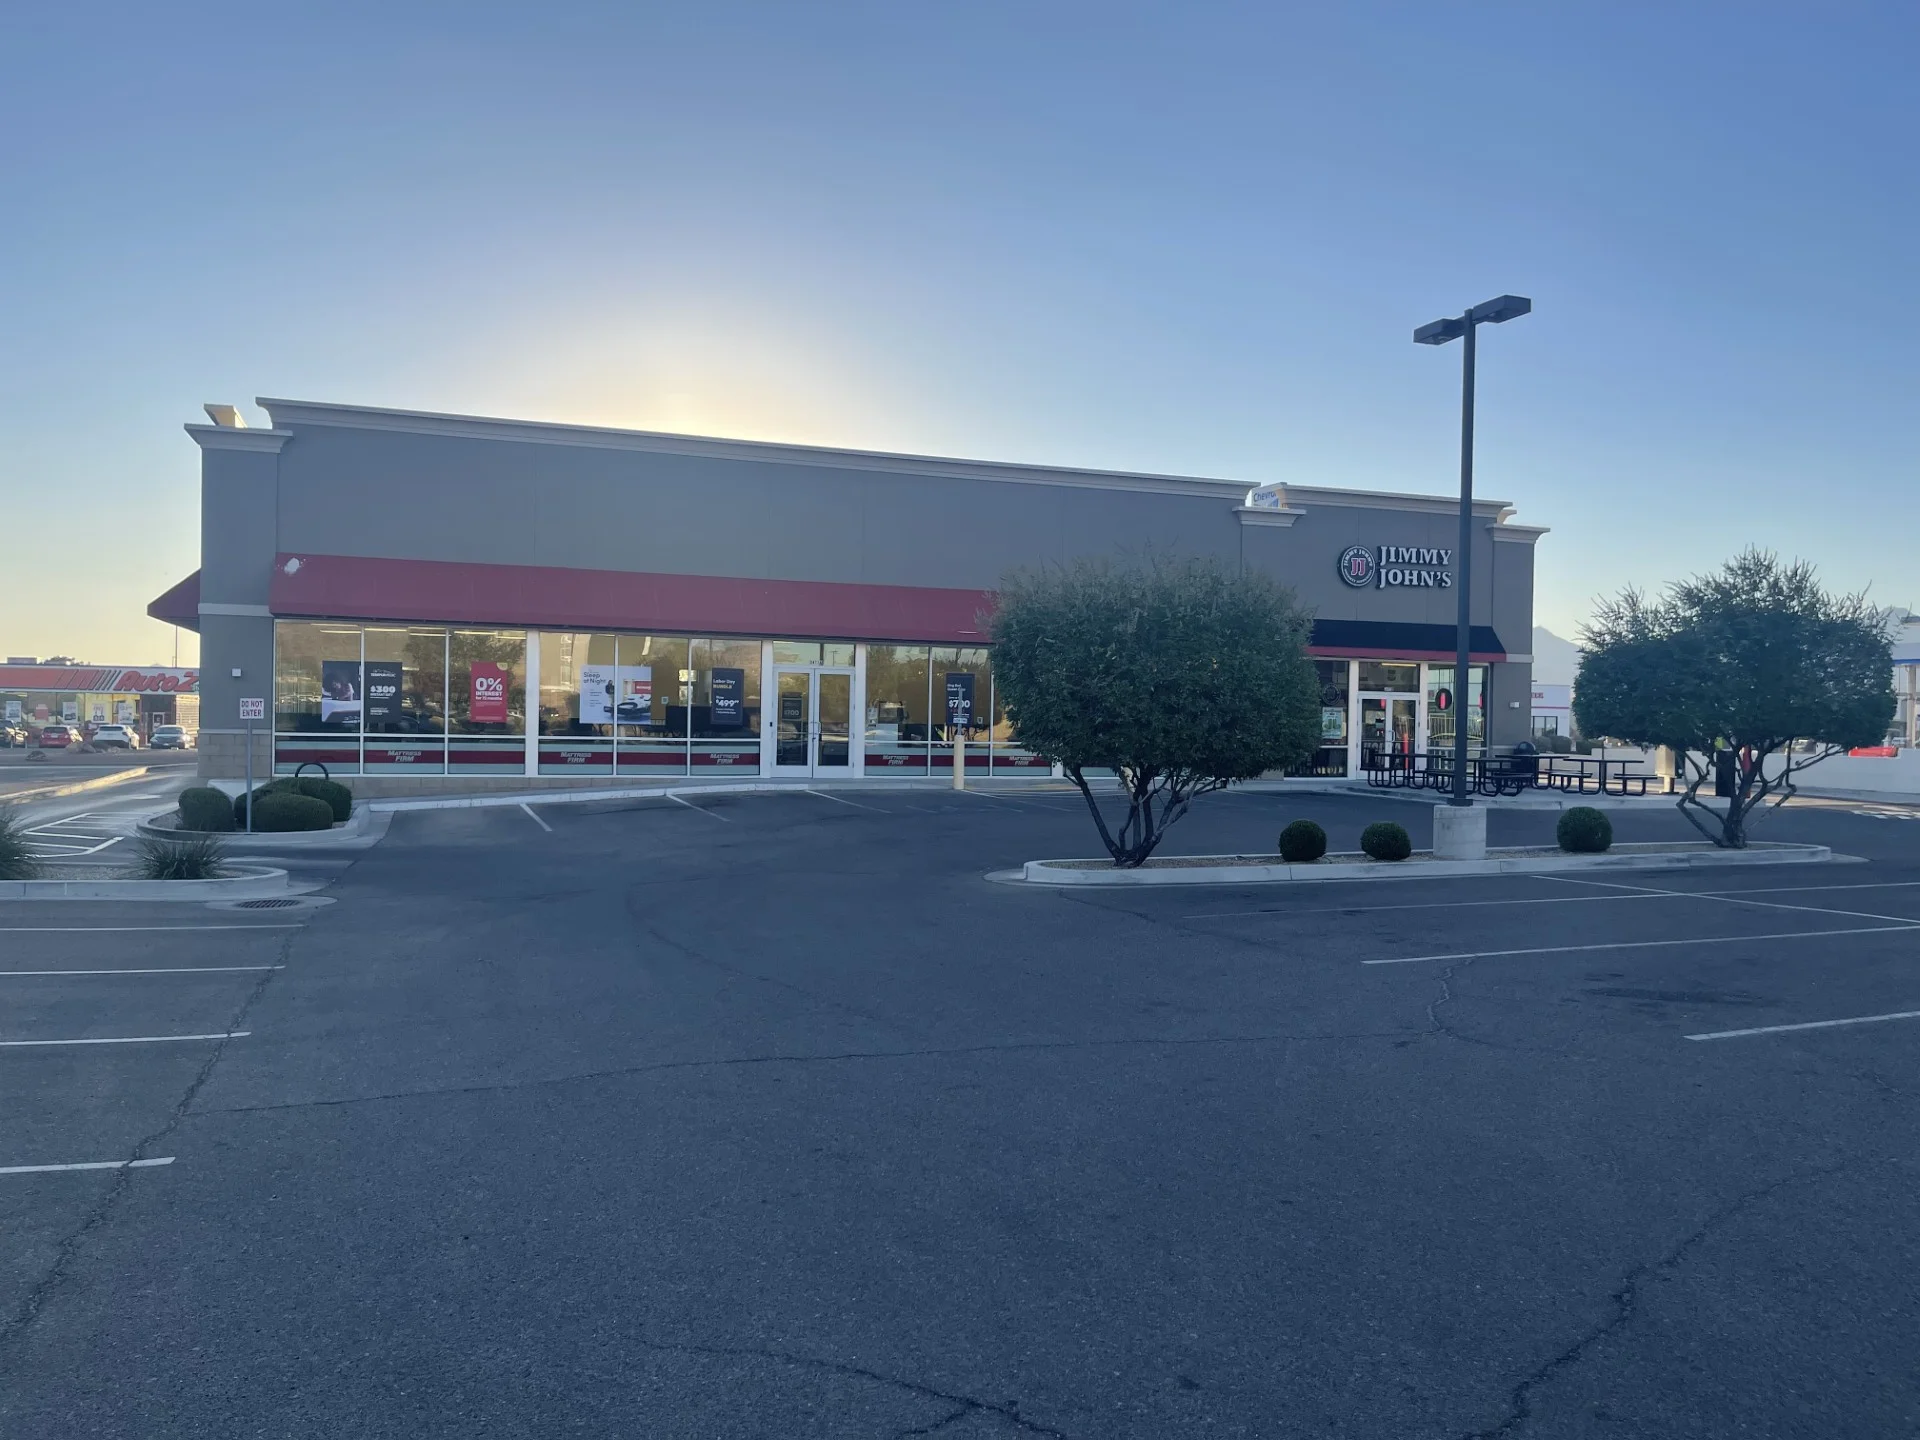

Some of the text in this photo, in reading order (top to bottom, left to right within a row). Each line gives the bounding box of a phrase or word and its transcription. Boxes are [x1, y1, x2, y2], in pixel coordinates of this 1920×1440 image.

[1253, 491, 1277, 502] Chevro
[1379, 545, 1452, 566] JIMMY
[1350, 557, 1366, 576] JJ
[1379, 568, 1452, 588] JOHN'S
[583, 671, 601, 679] Sleep
[475, 677, 503, 690] 0%
[241, 700, 263, 708] DO NOT
[242, 709, 262, 717] ENTER
